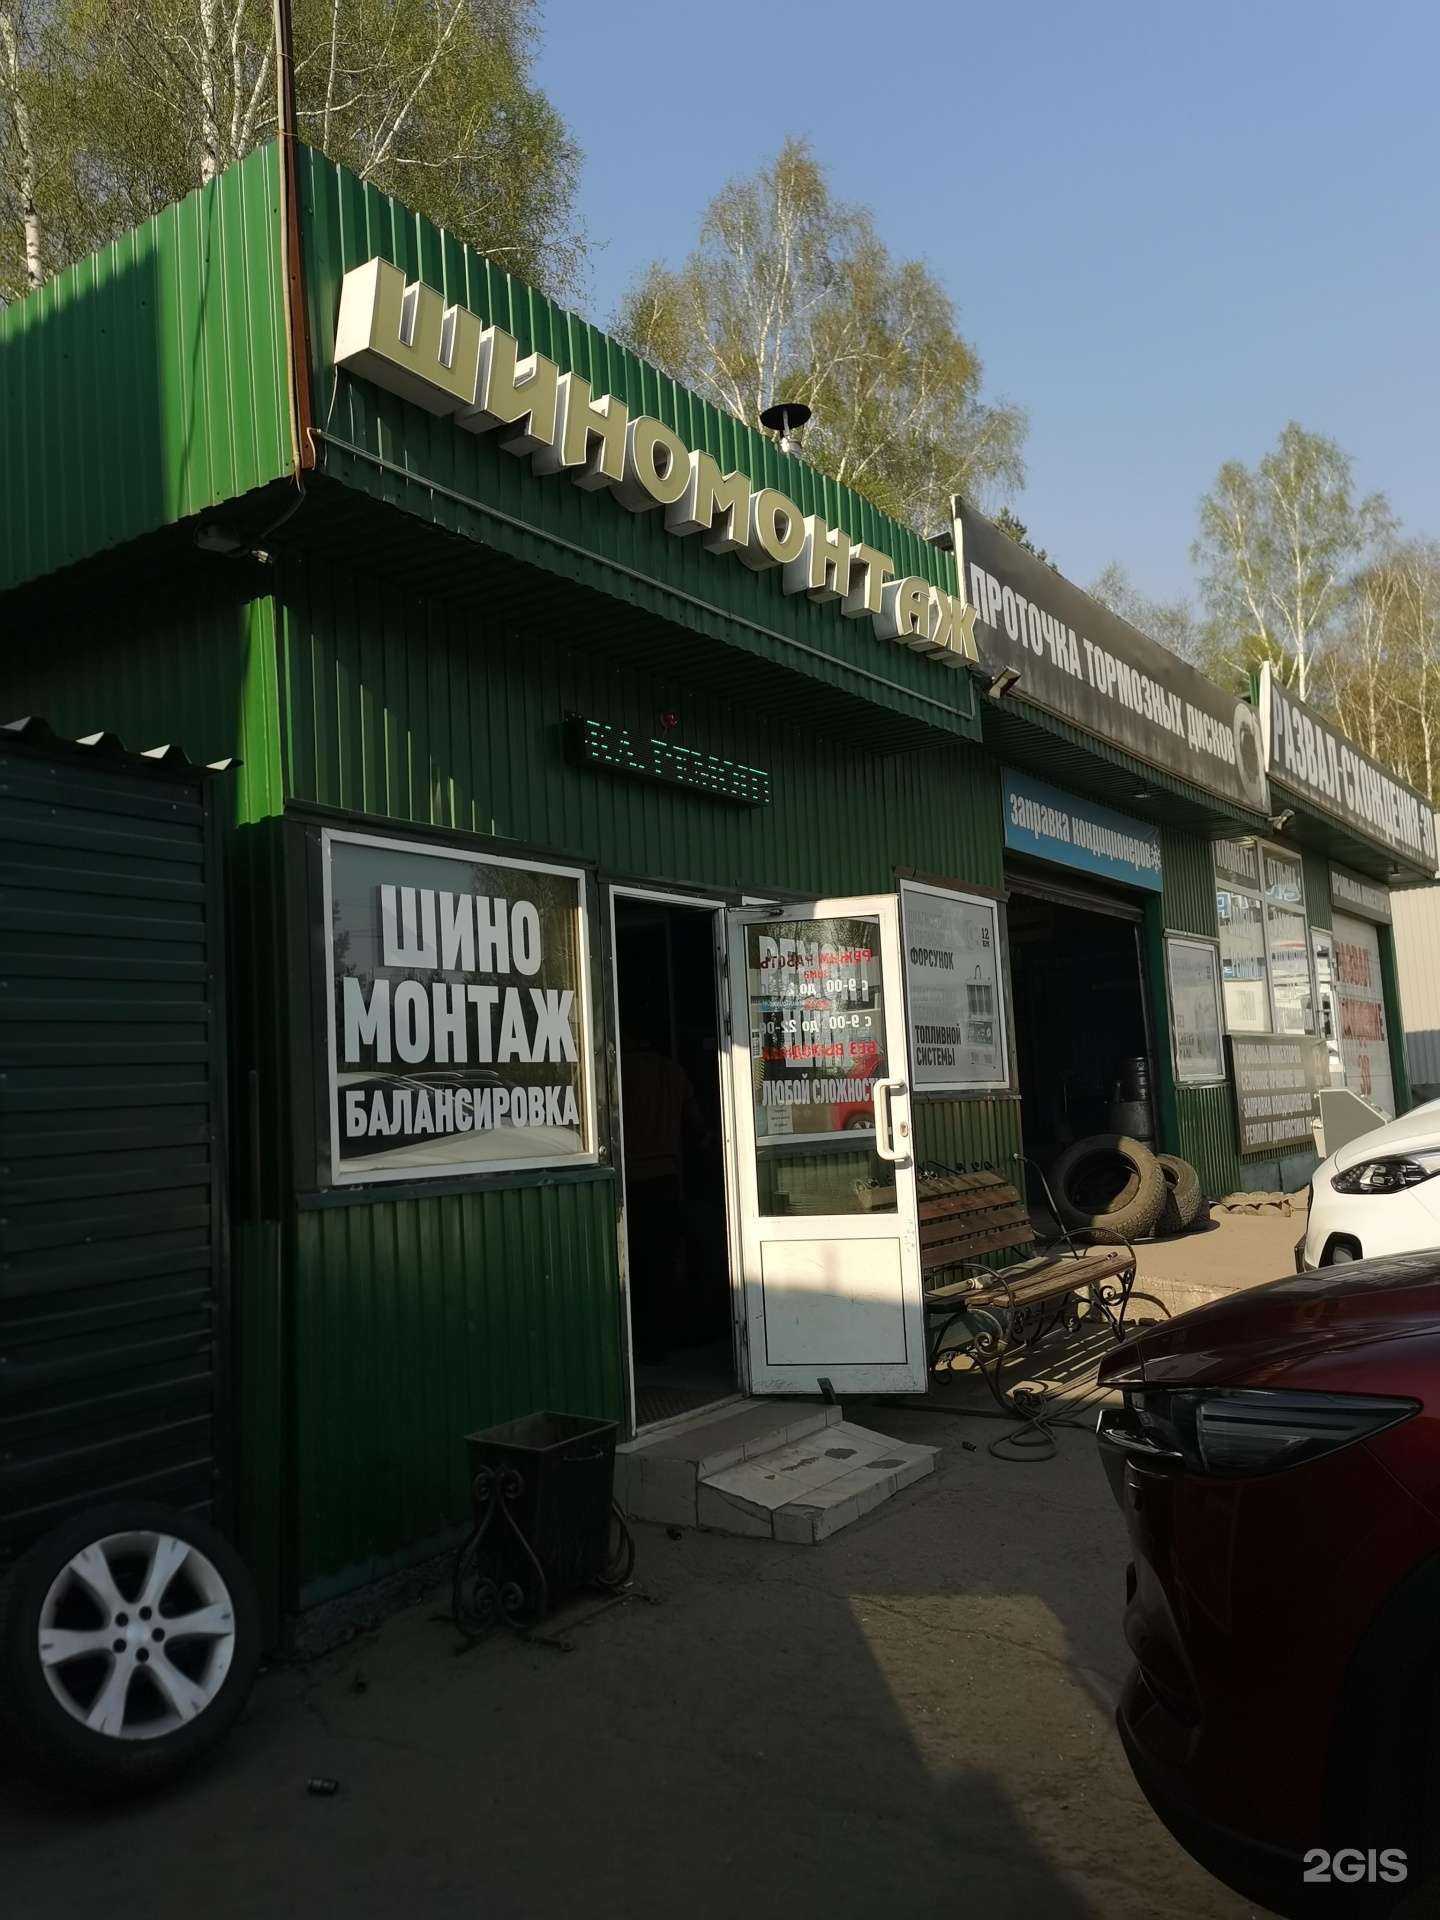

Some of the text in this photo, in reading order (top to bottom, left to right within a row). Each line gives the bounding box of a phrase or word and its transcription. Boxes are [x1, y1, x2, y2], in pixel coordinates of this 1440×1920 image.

[335, 256, 982, 666] ШИНОМОНТАЖ
[970, 562, 1236, 765] ПРОТОЧКА ТОРМОЗНЫХ ДИСКОВ
[381, 884, 541, 975] ШИНО
[910, 947, 954, 970] ФОРСУНОК
[344, 976, 578, 1063] МОНТАЖ
[915, 1023, 961, 1046] ТОПЛИВНОЙ
[917, 1046, 956, 1066] СИСТЕМЫ
[346, 1085, 579, 1137] БАЛАНСИРОВКА
[762, 1073, 879, 1106] ЛЮБОЙ СЛОЖНОСТ
